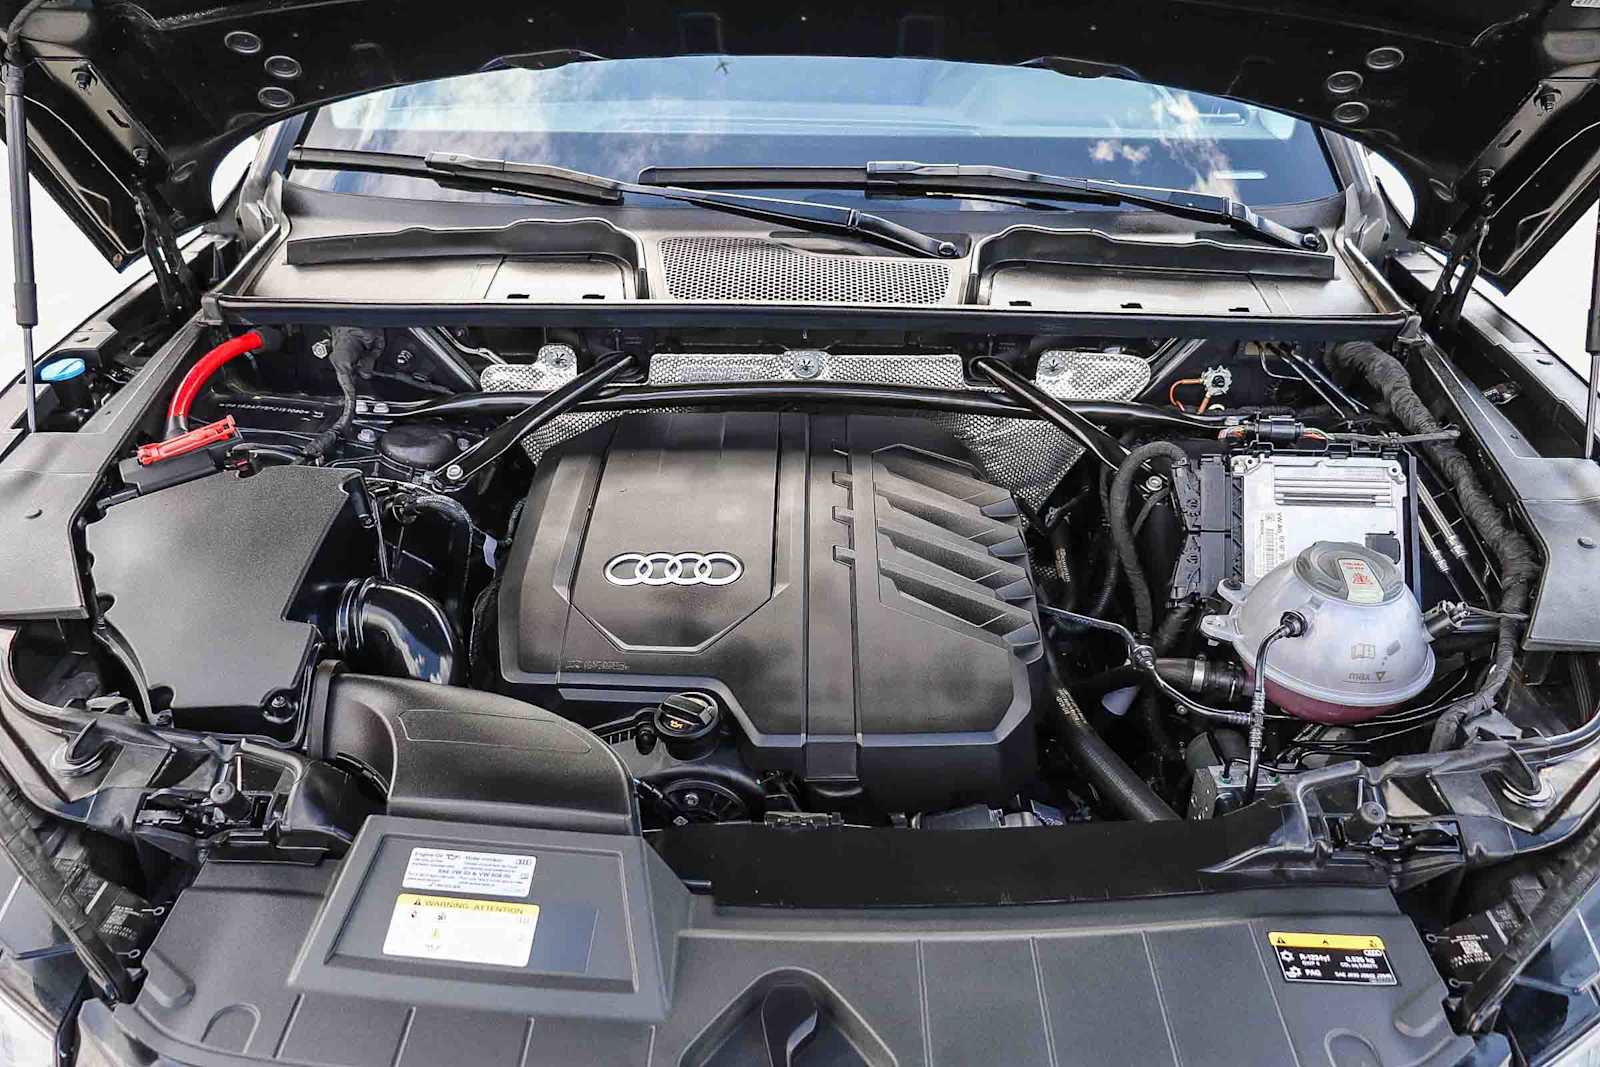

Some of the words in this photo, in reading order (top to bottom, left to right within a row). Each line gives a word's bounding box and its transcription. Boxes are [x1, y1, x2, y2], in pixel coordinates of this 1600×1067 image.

[1348, 671, 1370, 681] max
[425, 900, 469, 909] WARNING
[473, 904, 523, 914] ATTENTION
